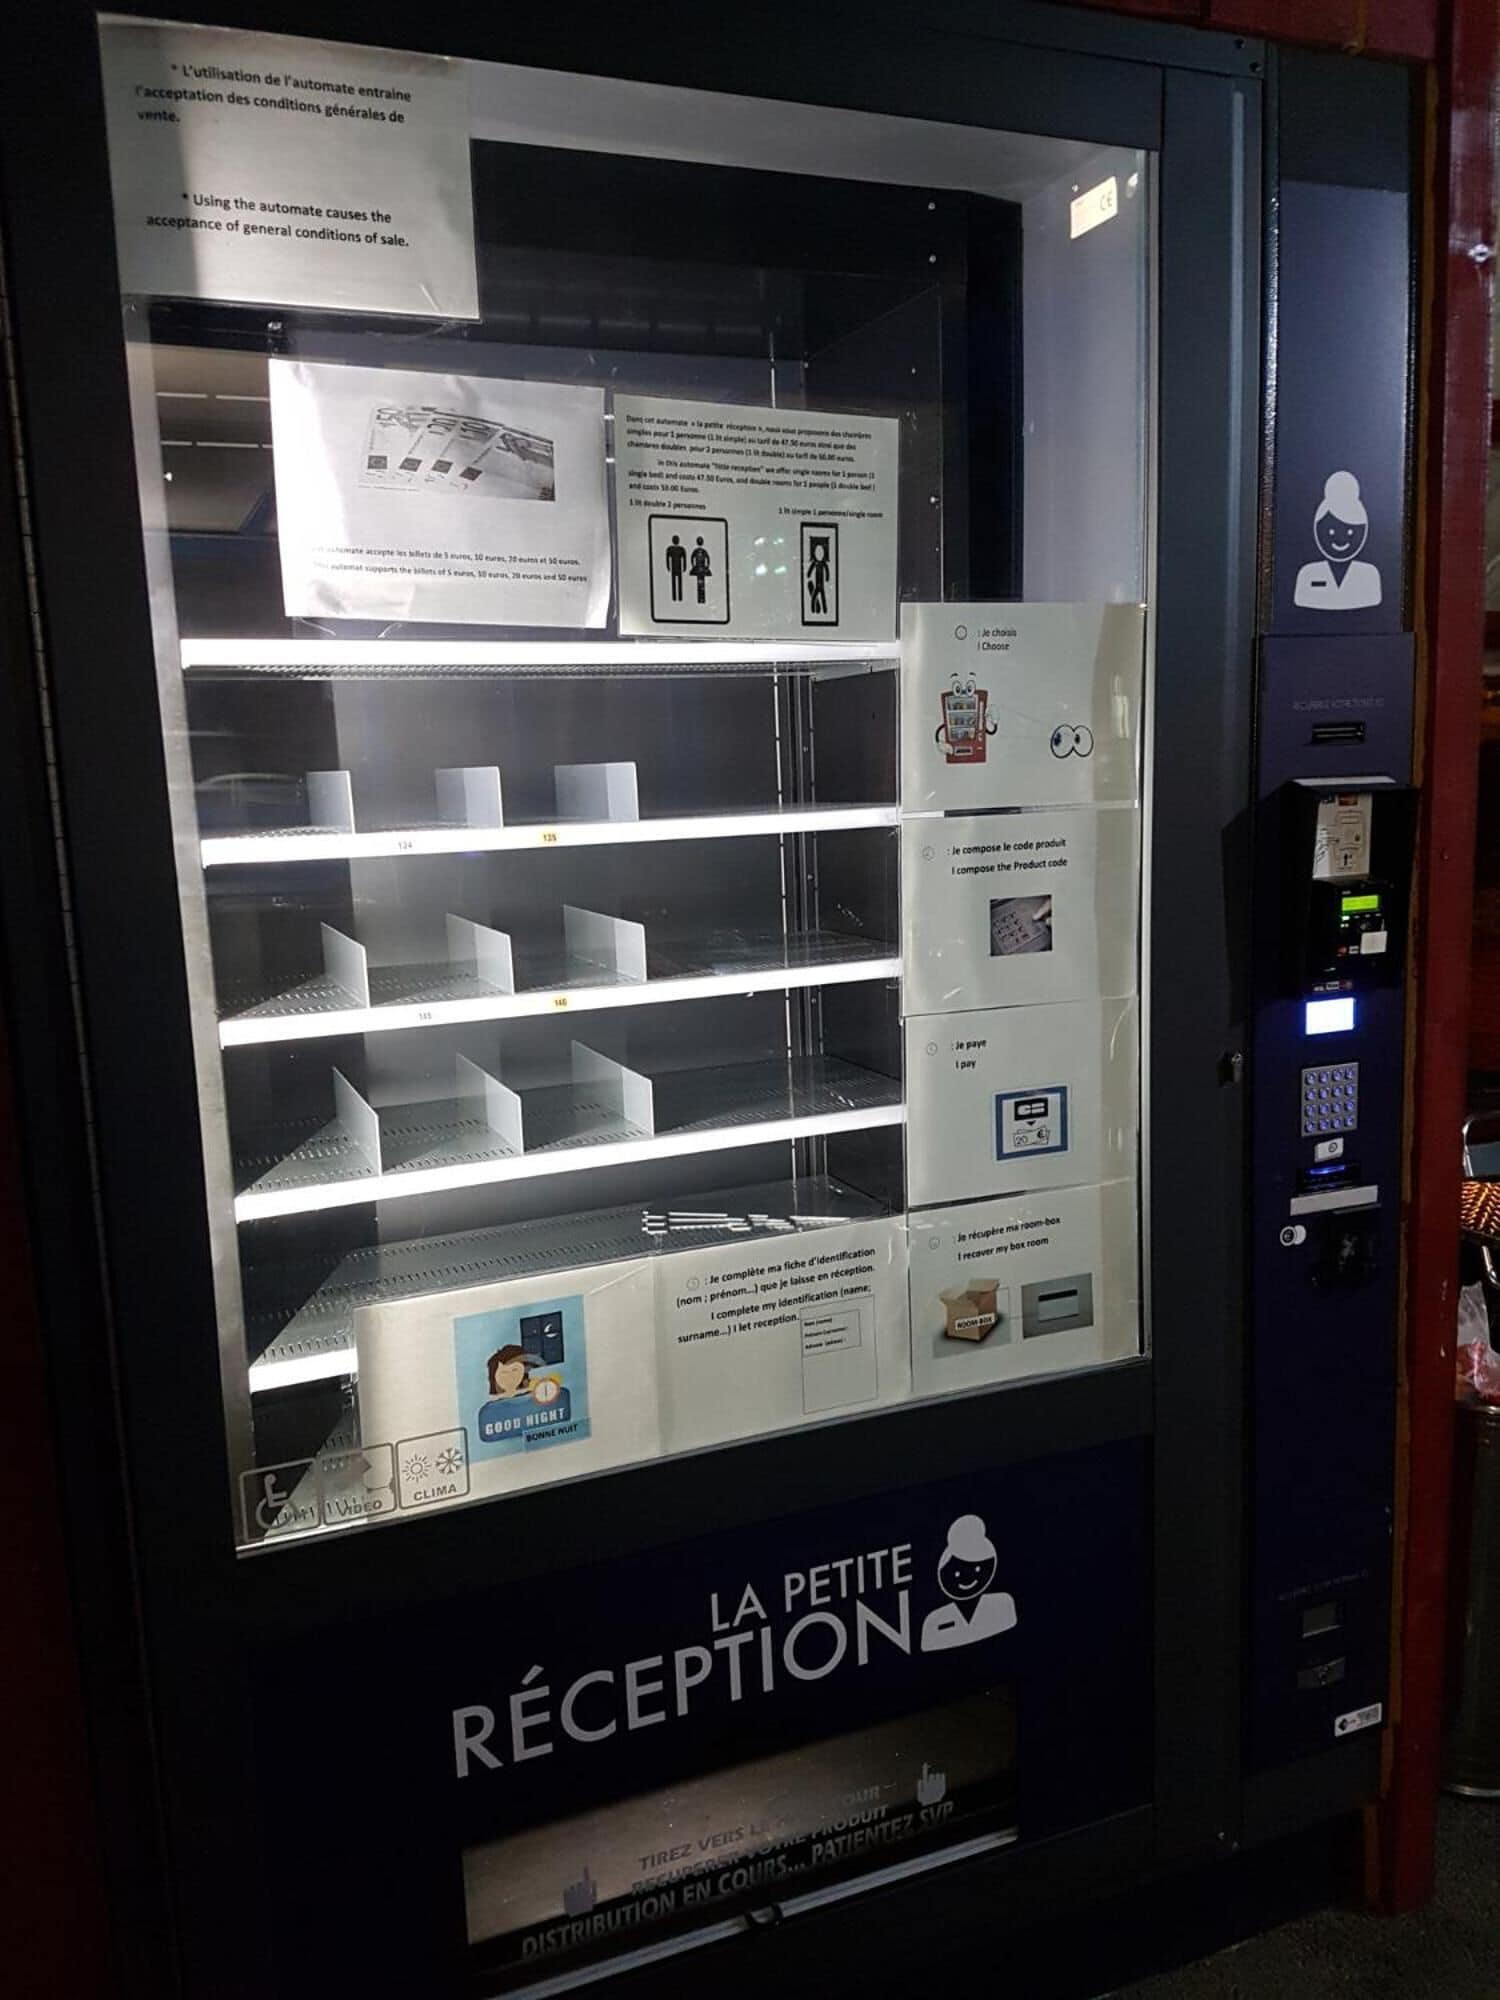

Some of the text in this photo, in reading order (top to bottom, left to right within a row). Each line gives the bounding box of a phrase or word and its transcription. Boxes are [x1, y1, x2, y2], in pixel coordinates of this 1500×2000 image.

[183, 64, 261, 83] L'utilisation
[264, 74, 281, 86] de
[285, 75, 355, 95] l'automate
[135, 85, 405, 123] l'acceptation des conditions générales de
[137, 110, 180, 122] vente.
[193, 193, 230, 211] Using
[234, 197, 256, 210] the
[260, 202, 323, 217] automate
[326, 208, 369, 221] causes
[371, 208, 392, 223] the
[146, 215, 409, 247] acceptance of general conditions of sale.
[982, 641, 1010, 651] Choose
[963, 844, 1001, 854] compose
[1003, 842, 1011, 851] le
[1013, 840, 1033, 850] code
[1036, 838, 1066, 851] produit
[957, 864, 995, 875] compose
[997, 862, 1011, 871] the
[1014, 859, 1046, 871] Product
[1048, 857, 1067, 868] code
[966, 1040, 987, 1050] paye
[961, 1060, 976, 1070] pay
[958, 1217, 1060, 1243] Je récupère ma room-box
[963, 1247, 994, 1260] recover
[995, 1244, 1008, 1255] my
[1010, 1240, 1025, 1251] box
[1026, 1237, 1049, 1248] room
[710, 1274, 720, 1284] Je
[722, 1266, 766, 1282] complète
[768, 1264, 782, 1274] ma
[784, 1260, 806, 1271] fiche
[808, 1248, 875, 1267] d'identification
[676, 1295, 703, 1309] (nom
[760, 1281, 778, 1293] que
[780, 1278, 788, 1291] je
[790, 1275, 815, 1286] laisse
[817, 1273, 829, 1281] en
[831, 1264, 874, 1279] réception.
[717, 1304, 760, 1320] complete
[762, 1301, 777, 1312] my
[778, 1289, 838, 1308] identification
[739, 1321, 752, 1332] let
[753, 1313, 799, 1328] reception.
[485, 1408, 565, 1435] GOOD NIGHT
[557, 1423, 577, 1436] NUIT
[414, 1484, 457, 1501] CLIMA
[711, 1543, 913, 1632] LA PETITE
[452, 1590, 912, 1778] RÉCEPTION
[638, 1843, 692, 1871] TIREZ
[698, 1828, 745, 1852] VERS
[520, 1888, 676, 1958] DISTRIBUTION
[683, 1879, 715, 1908] EN
[810, 1813, 916, 1868] PATIENTEZ
[918, 1799, 957, 1831] SVP
